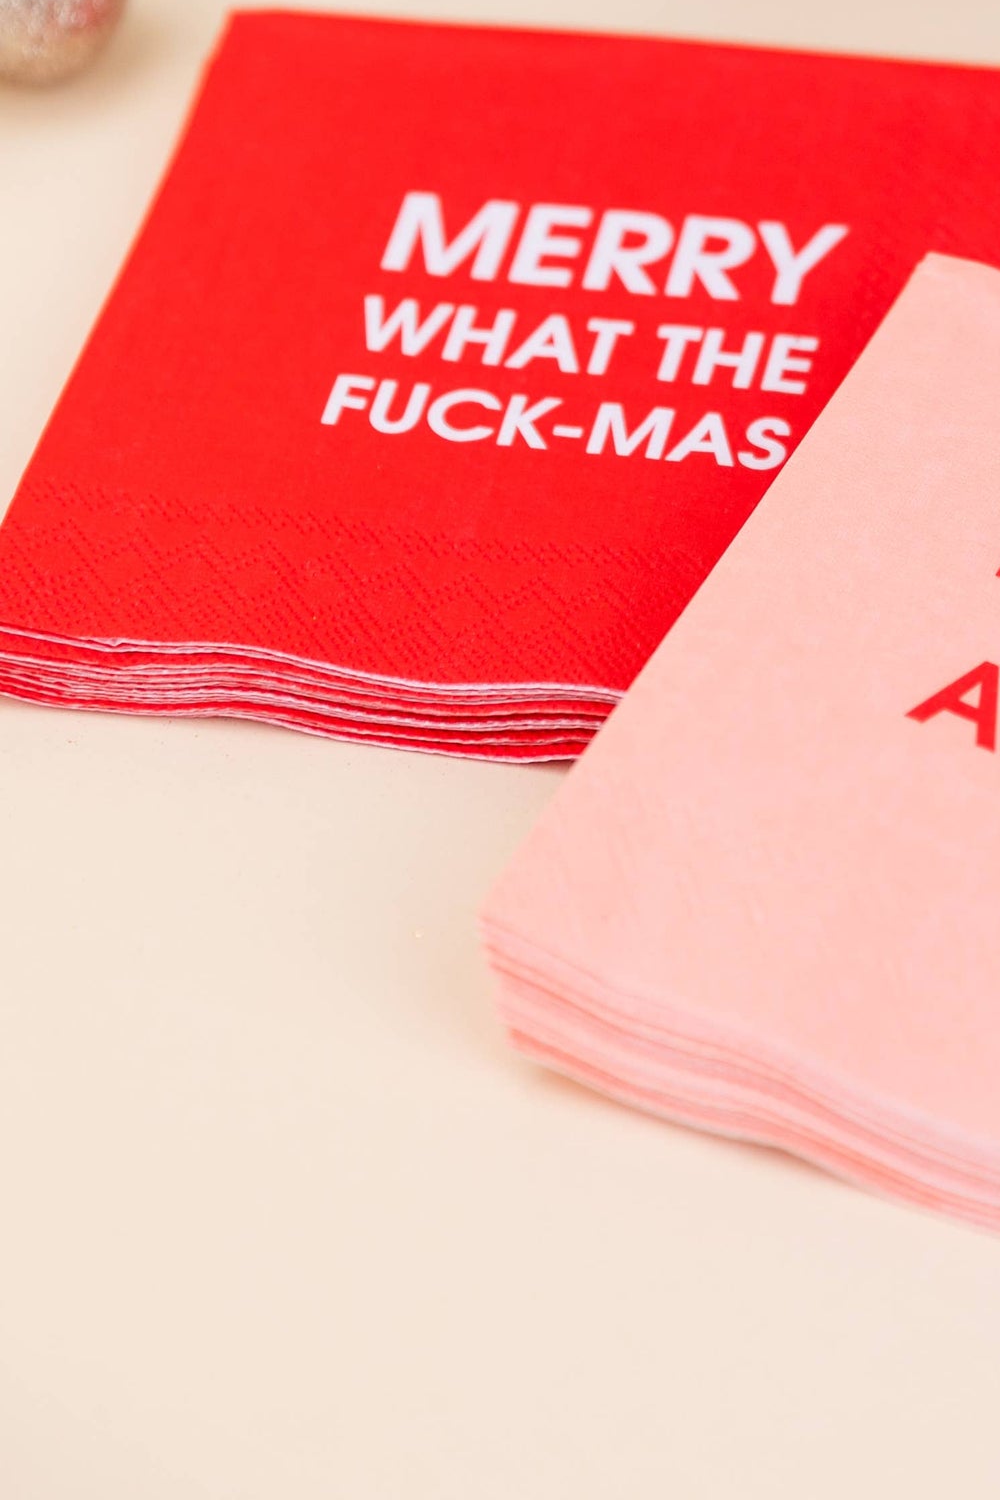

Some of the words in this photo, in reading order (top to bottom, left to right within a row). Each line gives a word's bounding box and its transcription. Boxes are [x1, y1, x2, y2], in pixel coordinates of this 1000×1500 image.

[381, 191, 848, 306] MERRY
[364, 294, 634, 376] WHAT
[656, 324, 819, 395] THE
[320, 373, 792, 471] FUCK-MAS
